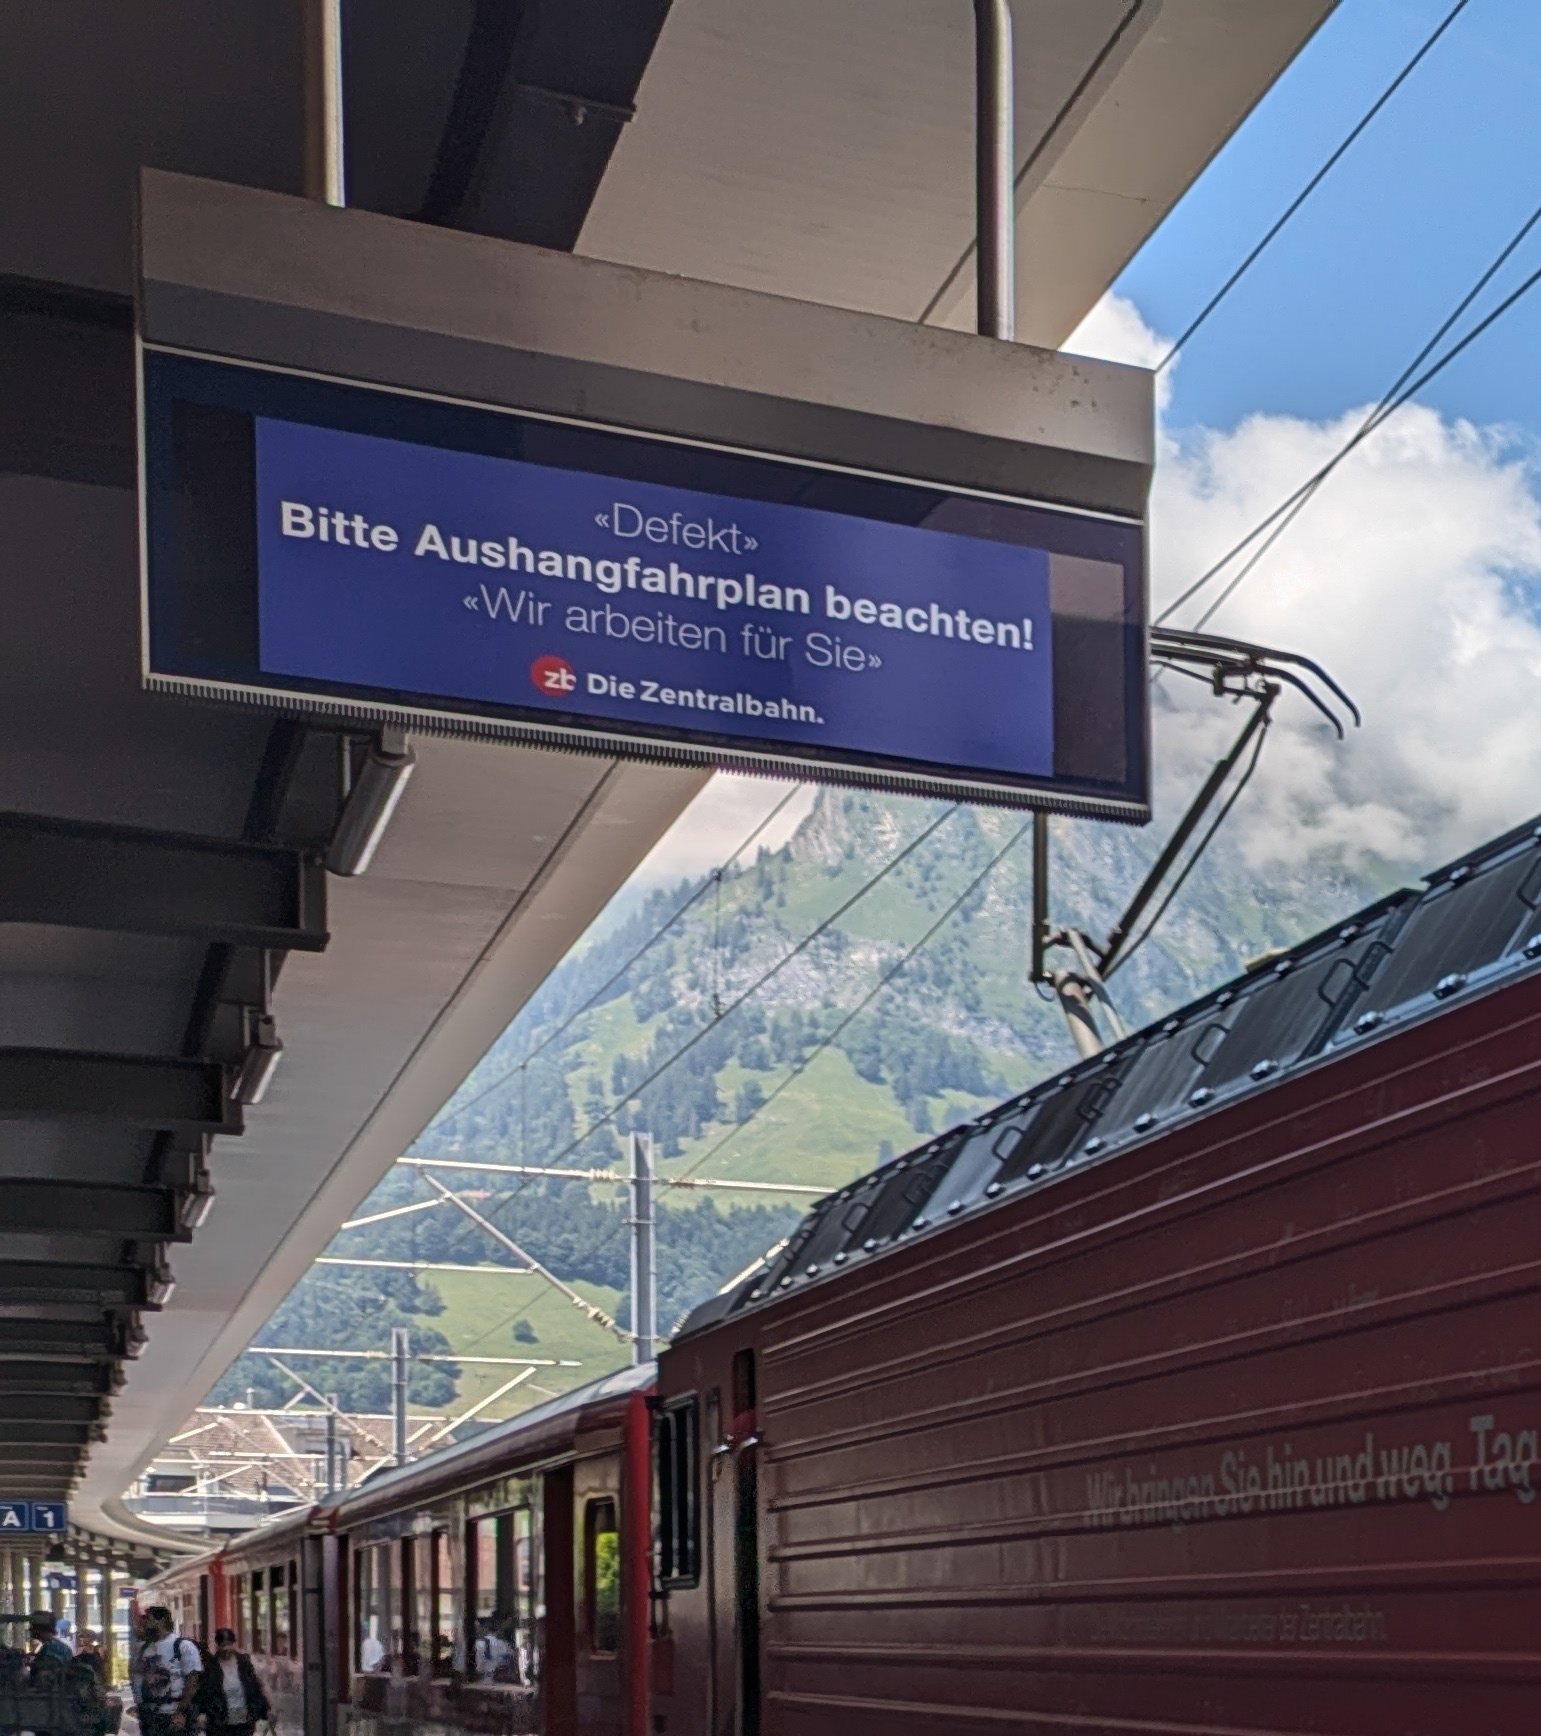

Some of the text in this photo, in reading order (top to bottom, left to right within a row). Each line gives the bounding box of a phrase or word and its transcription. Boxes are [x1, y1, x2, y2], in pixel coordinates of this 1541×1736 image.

[594, 503, 758, 555] «Defekt»
[280, 500, 1036, 653] Bitte Aushangfahrplan beachten!
[463, 583, 884, 674] «Wir arbeiten für Sie»
[586, 670, 826, 725] Die Zentralbahn.
[1085, 1468, 1122, 1527] Wir
[1216, 1448, 1261, 1518] Sie
[1260, 1441, 1311, 1511] hin
[1309, 1431, 1374, 1507] und
[1376, 1438, 1453, 1512] weg.
[1469, 1413, 1539, 1504] Tag
